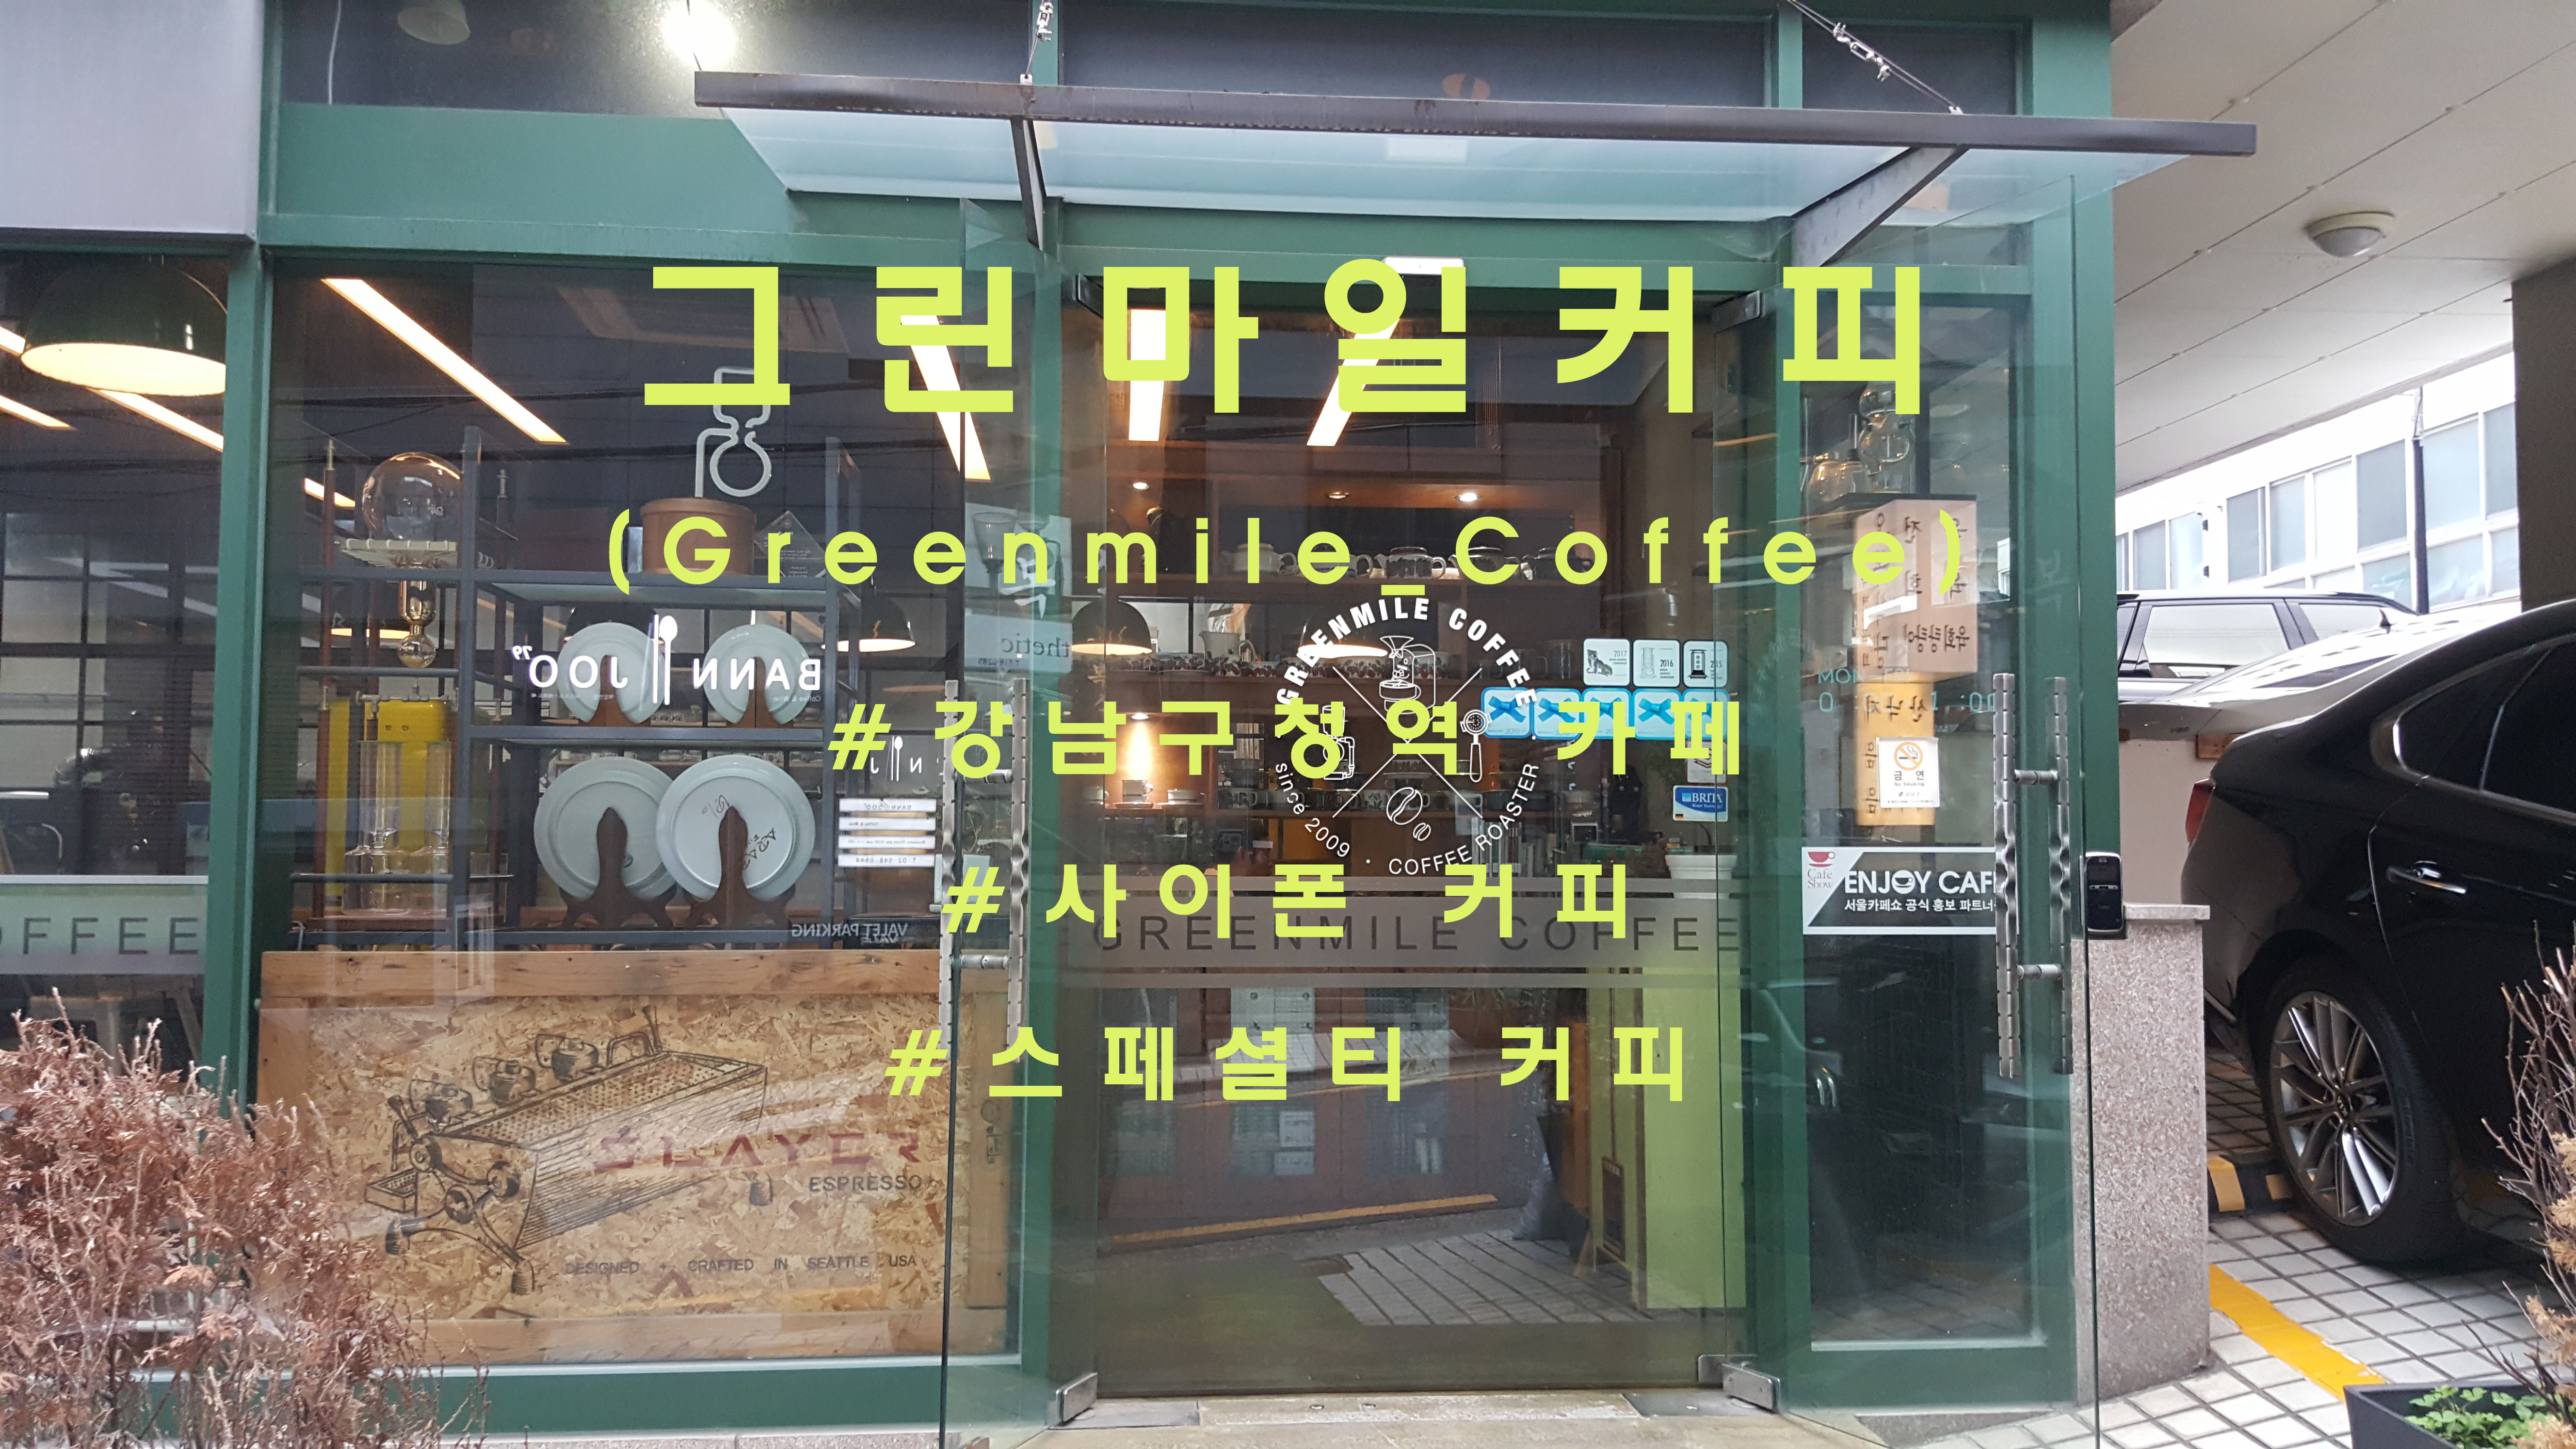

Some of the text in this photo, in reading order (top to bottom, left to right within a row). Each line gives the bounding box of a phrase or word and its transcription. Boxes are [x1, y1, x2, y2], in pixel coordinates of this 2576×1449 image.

[1277, 597, 1537, 707] GREENMILE COFFEE
[1275, 763, 1351, 857] since 2009
[1692, 792, 1723, 803] BRITA
[1389, 763, 1539, 875] COFFEE ROASTER
[1807, 878, 1833, 889] Show
[1844, 869, 1996, 894] ENJOY CAF
[1844, 899, 1996, 912] 서울카페쇼 공식 홍보 파트너
[0, 917, 198, 954] FFEE
[1093, 916, 1739, 951] GREENMILE COFFEE
[594, 1133, 920, 1169] SLAYER
[809, 1175, 922, 1191] ESPRESSO
[565, 1261, 639, 1274] DESIGNED
[688, 1258, 755, 1272] CRAFTED
[774, 1258, 788, 1270] IN
[807, 1256, 869, 1269] SEATTLE
[888, 1255, 917, 1268] USA
